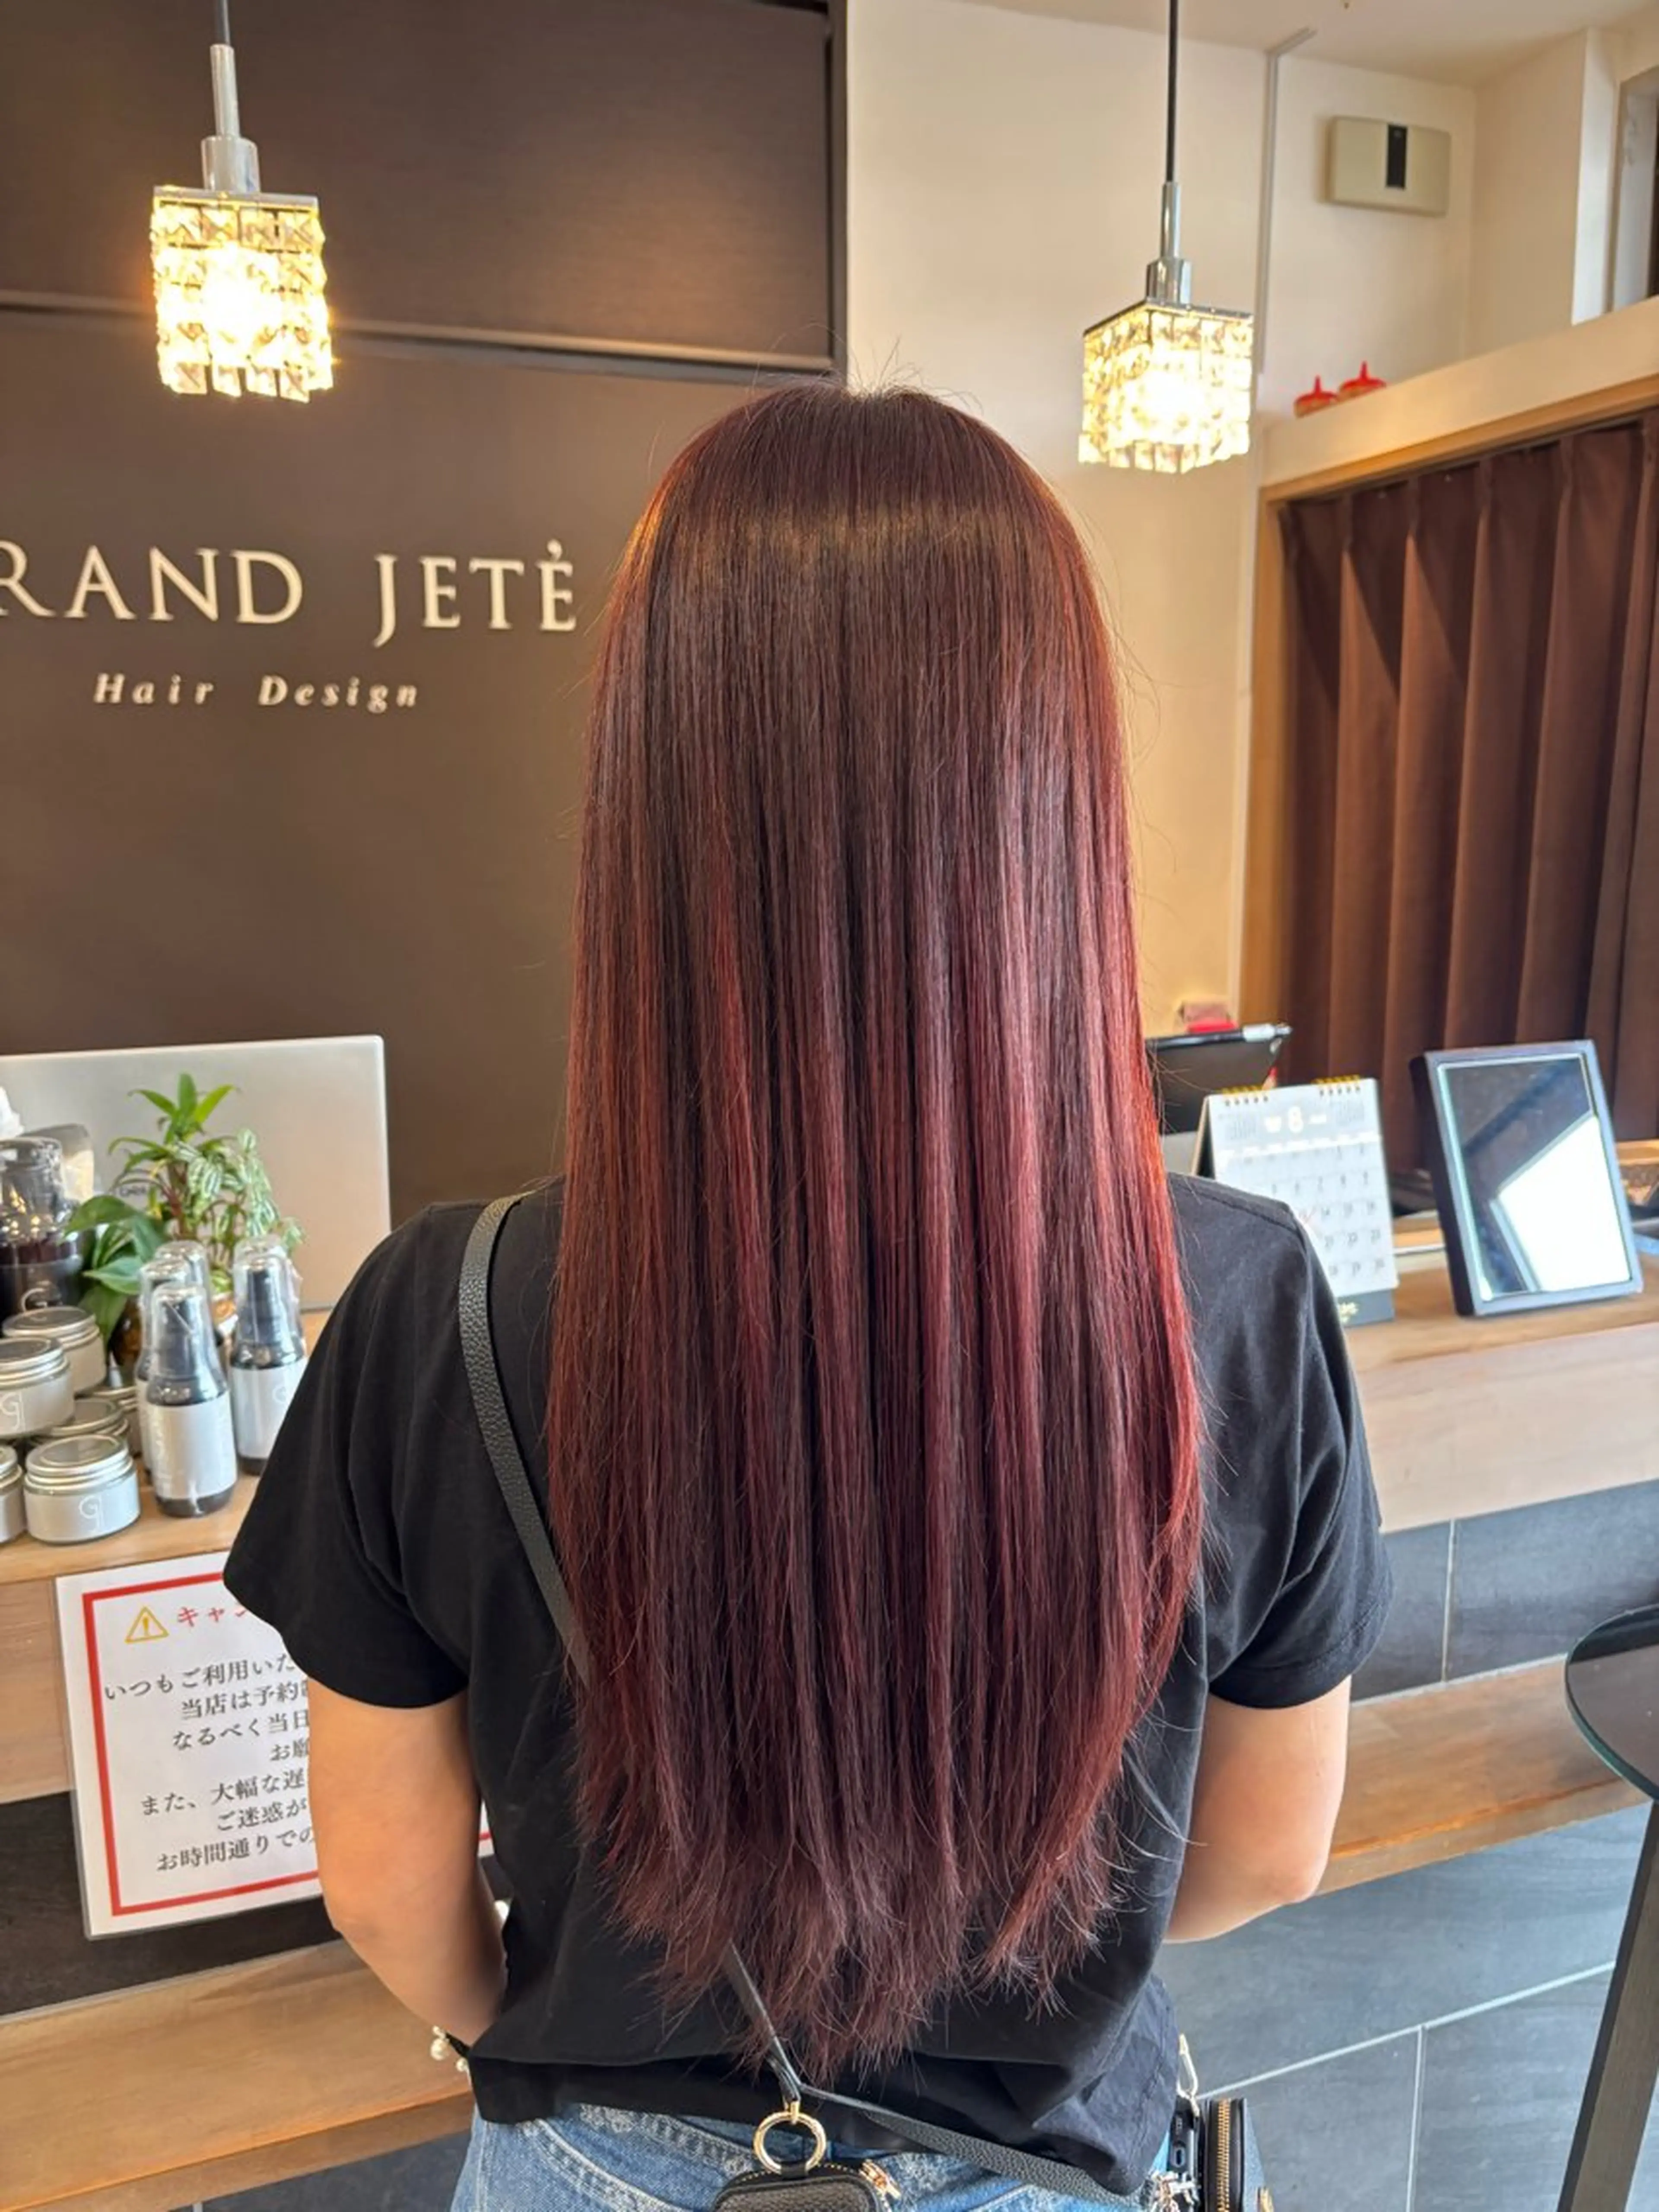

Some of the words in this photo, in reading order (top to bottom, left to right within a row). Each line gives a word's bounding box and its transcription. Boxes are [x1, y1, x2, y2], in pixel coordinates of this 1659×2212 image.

[0, 540, 303, 624] RAND
[94, 673, 214, 705] Hair
[259, 675, 418, 713] Design
